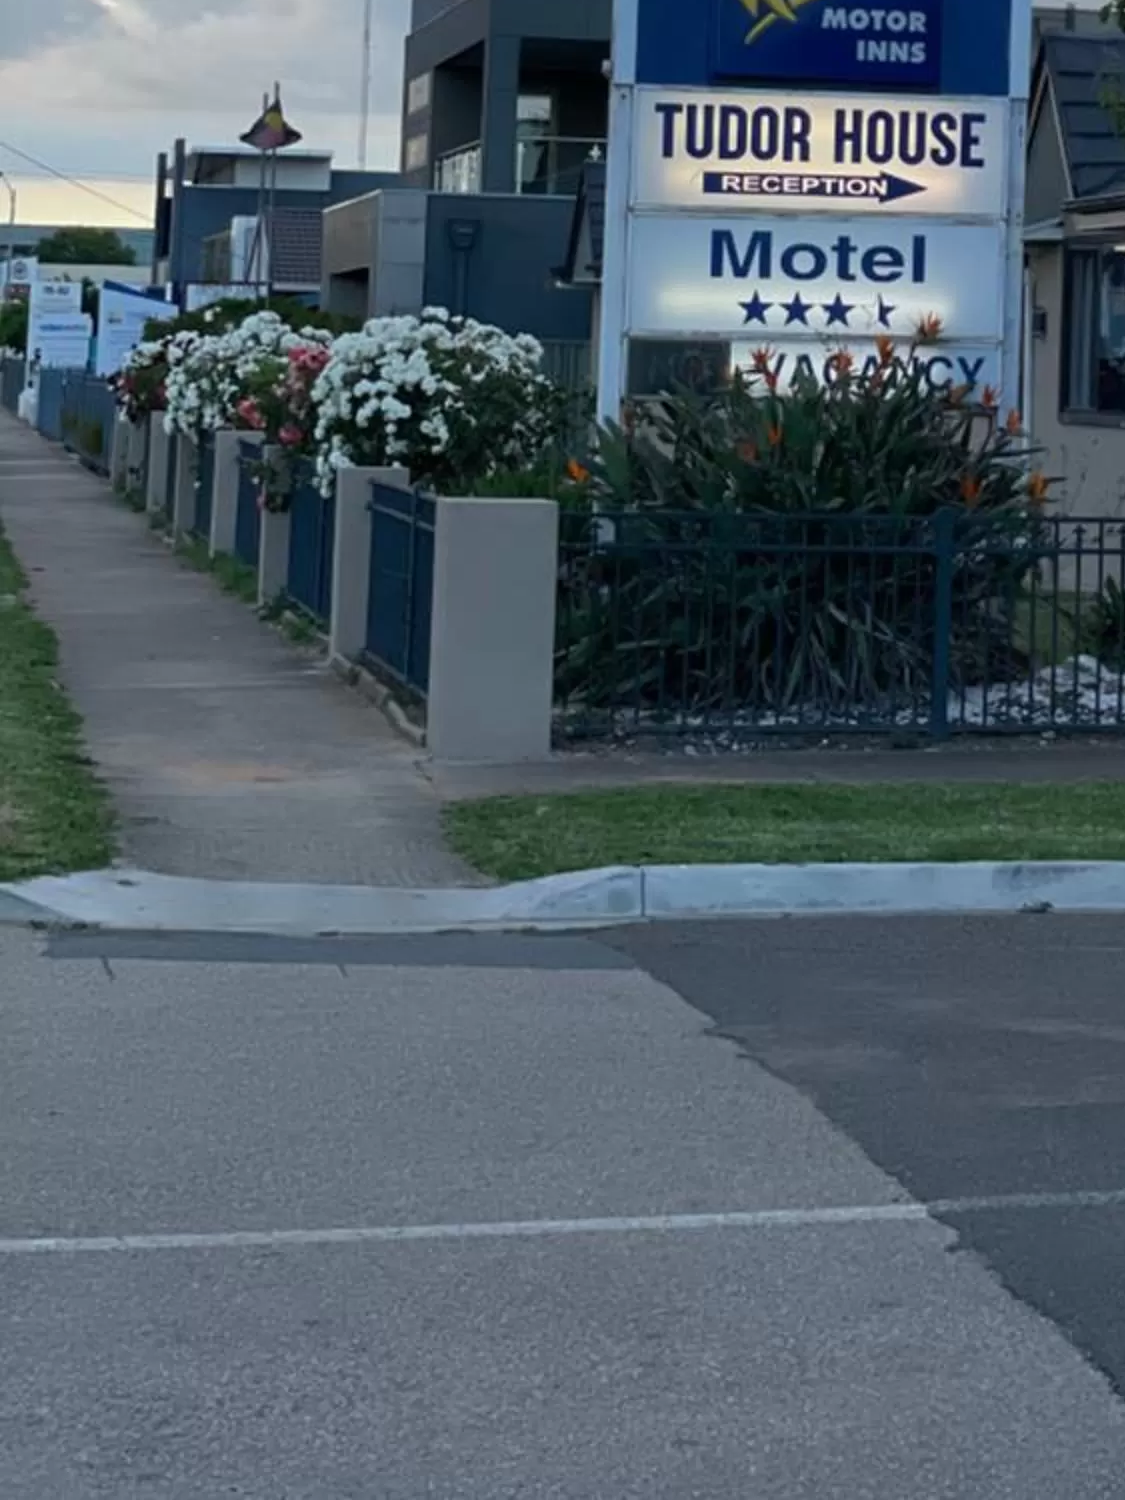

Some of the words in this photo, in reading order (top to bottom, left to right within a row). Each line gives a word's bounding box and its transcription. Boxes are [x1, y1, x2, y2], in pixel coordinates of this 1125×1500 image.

[821, 8, 926, 32] MOTOR
[856, 40, 926, 63] INNS
[655, 102, 812, 163] TUDOR
[834, 109, 986, 168] HOUSE
[721, 175, 888, 195] RECEPTION
[710, 229, 926, 283] Motel
